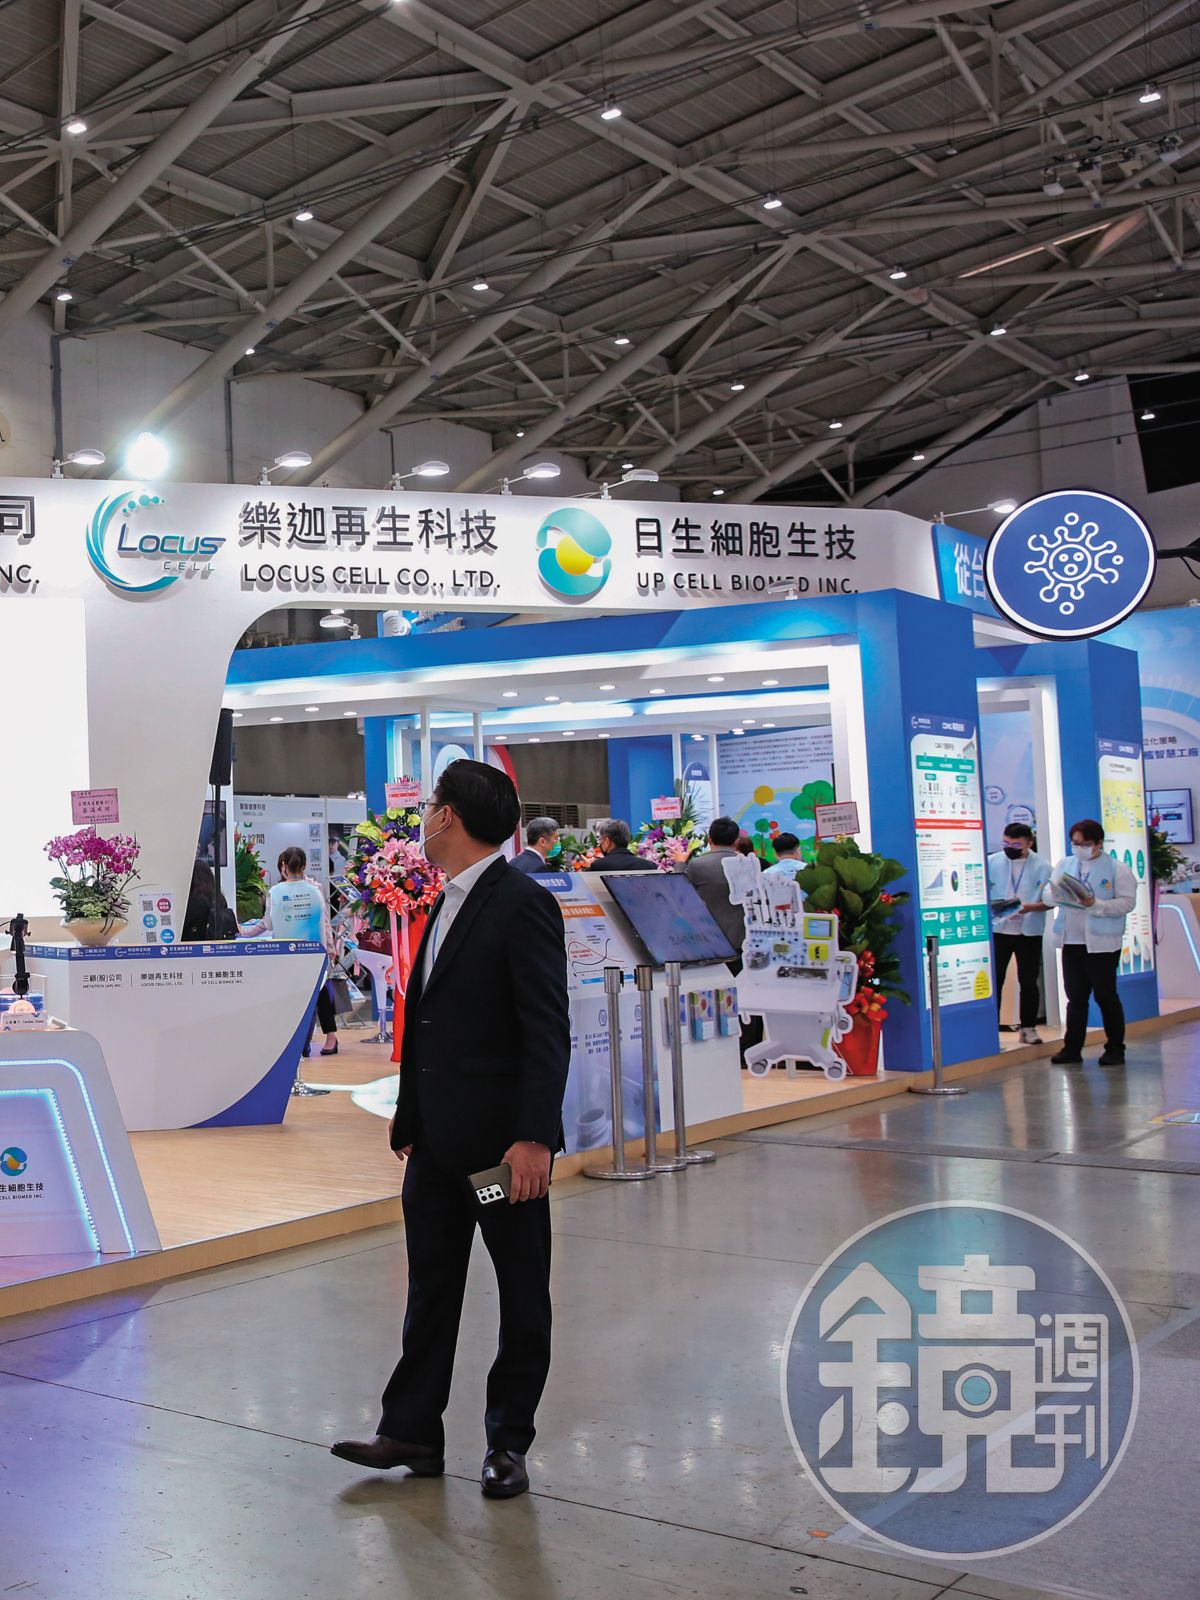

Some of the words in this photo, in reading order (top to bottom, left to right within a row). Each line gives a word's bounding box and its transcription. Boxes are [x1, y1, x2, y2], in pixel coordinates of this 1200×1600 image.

[241, 501, 499, 552] 樂迦再生科技
[635, 517, 857, 561] 日生細胞生技
[161, 561, 216, 572] CELL
[243, 563, 325, 585] LOCUS
[332, 565, 390, 587] CELL
[397, 568, 444, 590] CO.,
[452, 569, 501, 589] LTD.
[637, 571, 665, 590] UP
[673, 572, 722, 591] CELL
[731, 574, 810, 592] BIOD
[818, 577, 859, 593] INC.
